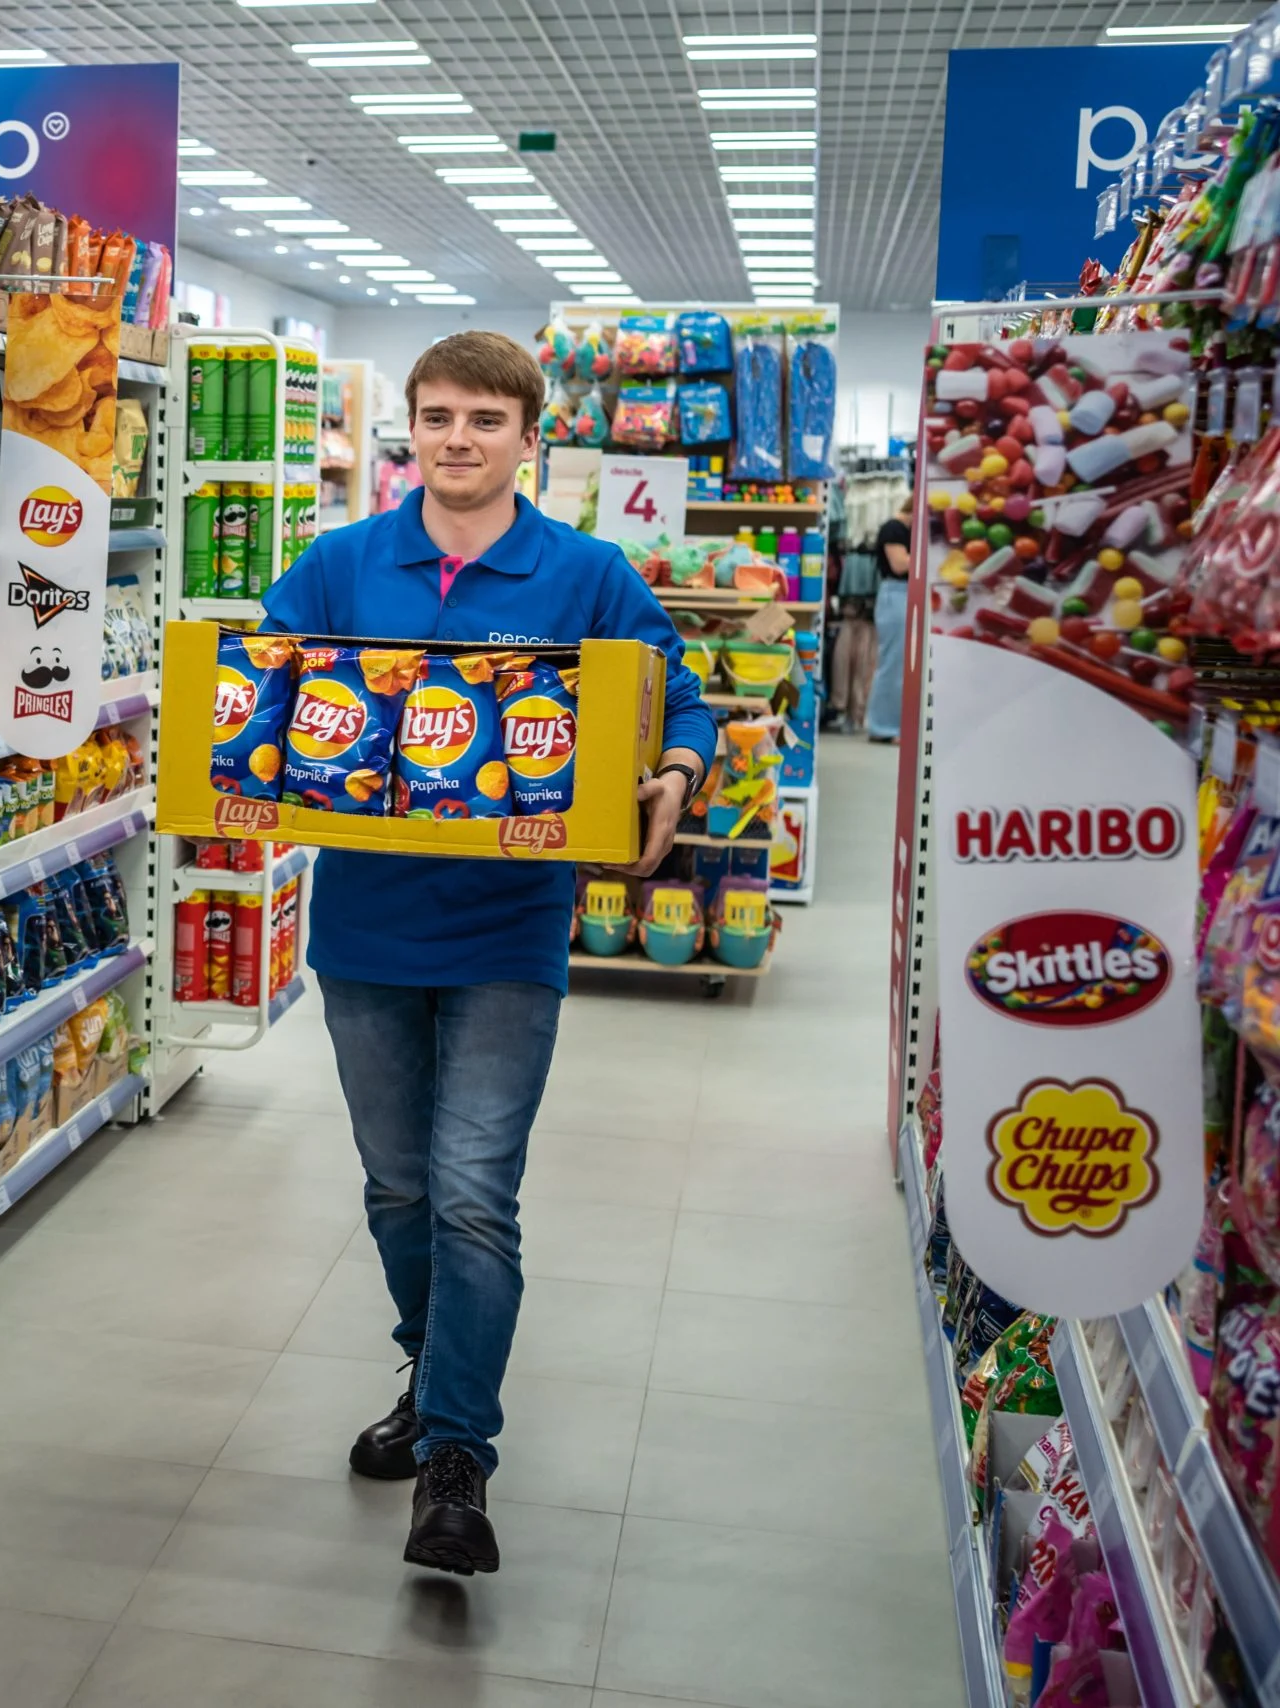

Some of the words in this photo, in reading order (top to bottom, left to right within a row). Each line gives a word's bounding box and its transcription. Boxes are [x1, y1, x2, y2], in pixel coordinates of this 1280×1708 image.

[22, 500, 80, 536] Lay's
[624, 480, 657, 522] 4
[9, 582, 90, 610] Doritos
[17, 690, 70, 720] PRINGLES
[289, 695, 362, 742] Lay's
[401, 701, 472, 750] Lay's
[504, 713, 572, 760] Lay's
[213, 756, 235, 768] rika
[284, 763, 330, 784] Paprika
[410, 777, 460, 795] Paprika
[515, 787, 563, 803] Paprika
[219, 800, 277, 835] Lay's
[503, 815, 562, 853] Lay's
[955, 807, 1177, 858] HARIBO
[986, 941, 1160, 994] Skittles
[1013, 1115, 1138, 1161] Chupa
[1007, 1154, 1132, 1212] Chups
